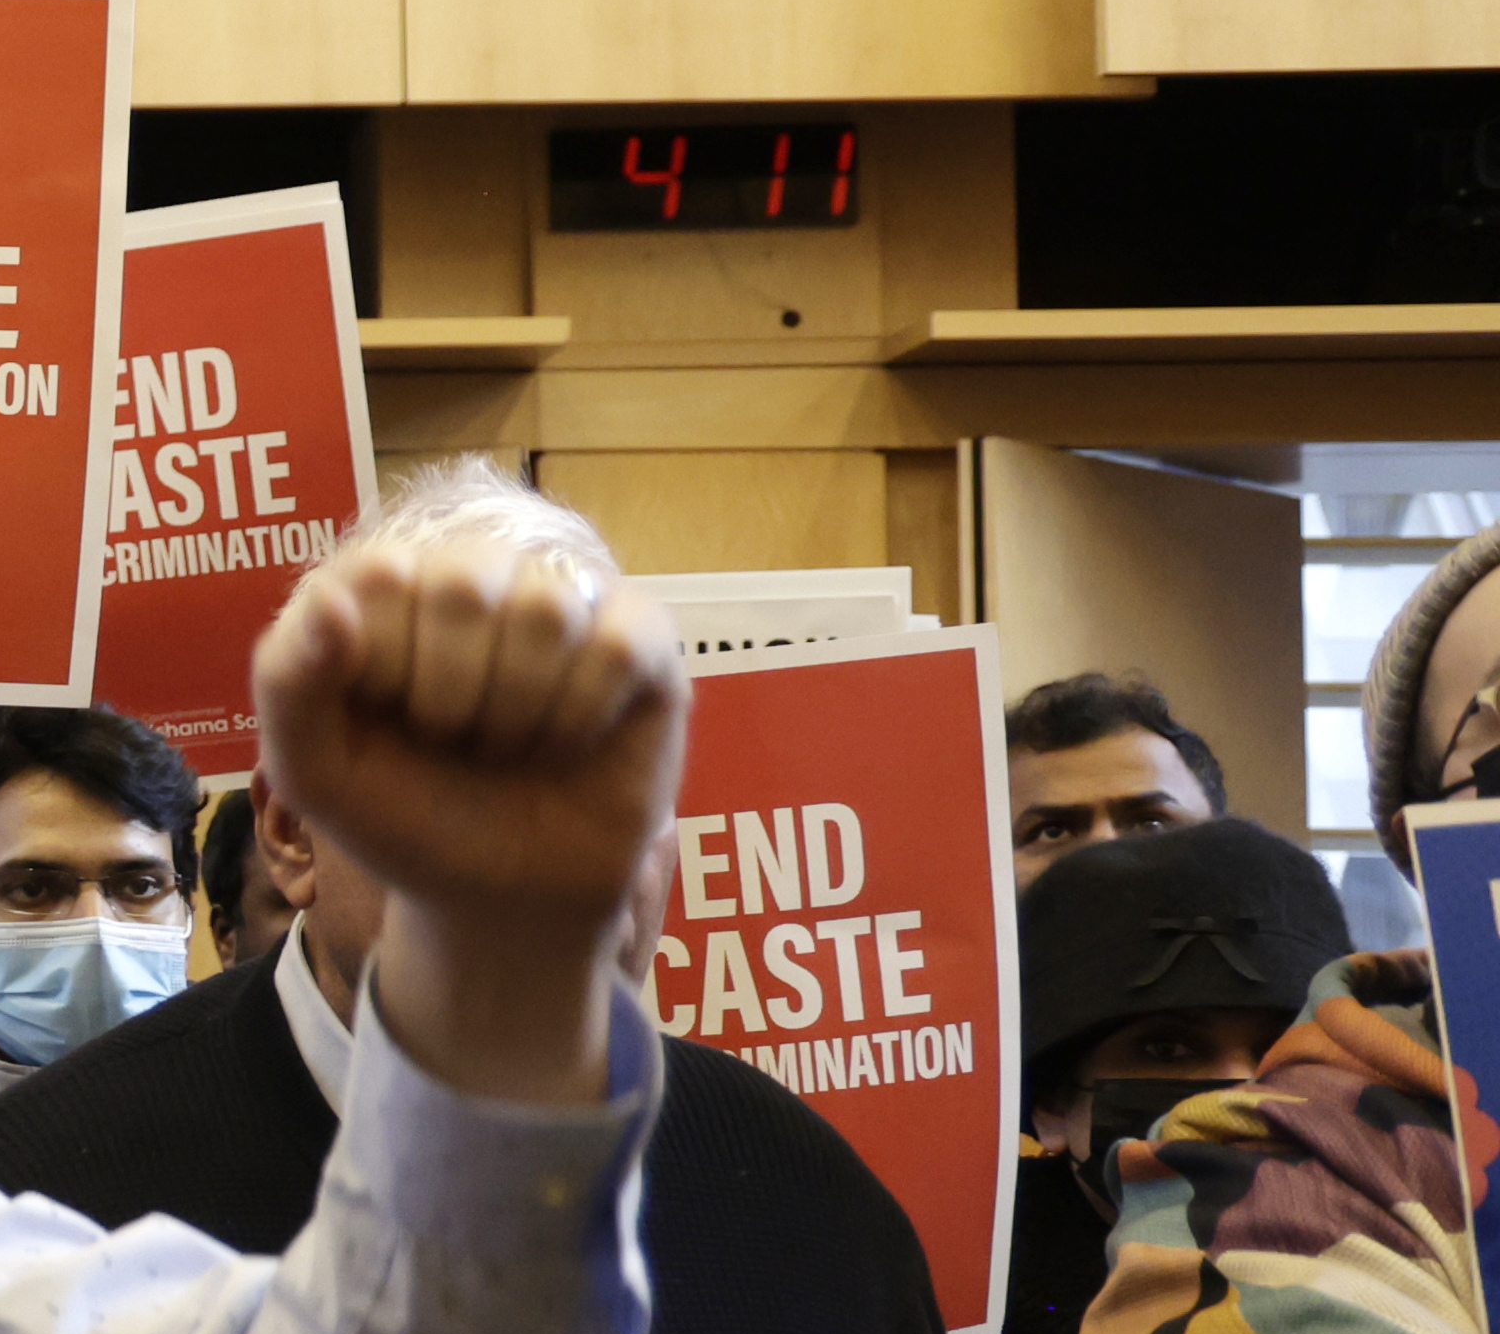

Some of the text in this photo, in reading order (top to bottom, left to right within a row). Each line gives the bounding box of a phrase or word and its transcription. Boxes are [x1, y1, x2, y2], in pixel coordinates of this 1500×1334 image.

[623, 135, 688, 219] 4
[149, 719, 229, 738] shama
[676, 802, 866, 921] END
[645, 910, 933, 1039] CASTE
[722, 1020, 975, 1096] MINATION
